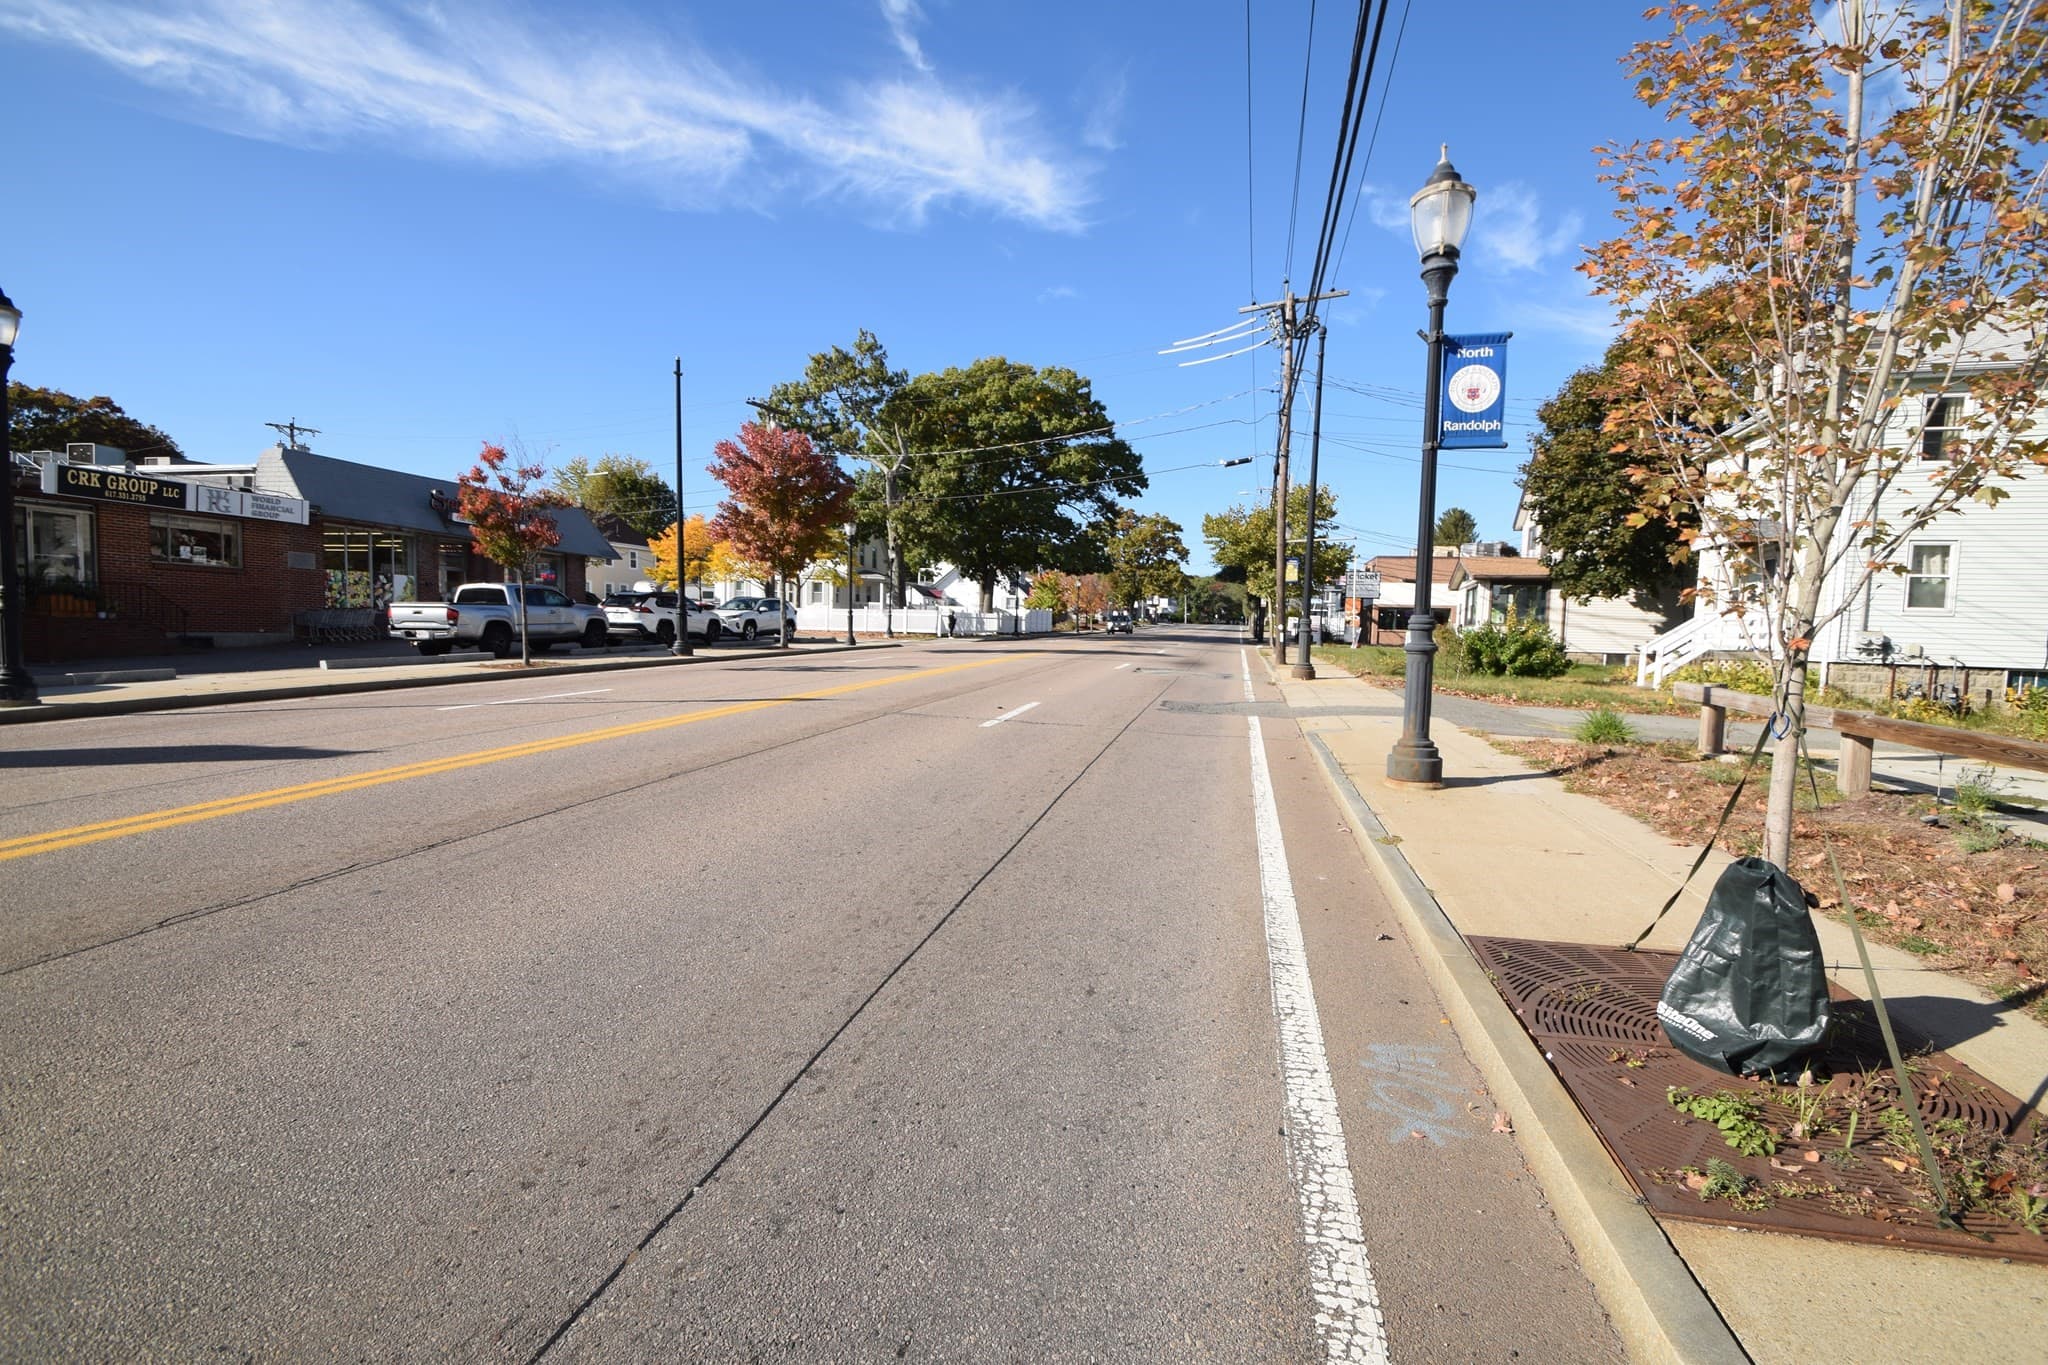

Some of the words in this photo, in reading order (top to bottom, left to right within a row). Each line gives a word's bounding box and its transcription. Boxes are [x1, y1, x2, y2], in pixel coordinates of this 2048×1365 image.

[1457, 347, 1493, 359] North
[1443, 420, 1501, 432] Randolph
[67, 470, 101, 488] CRK
[107, 475, 158, 494] GROUP
[163, 487, 180, 498] LLC
[251, 495, 281, 505] WORLD
[251, 502, 295, 514] FINANCIAL
[251, 511, 280, 519] GROUP
